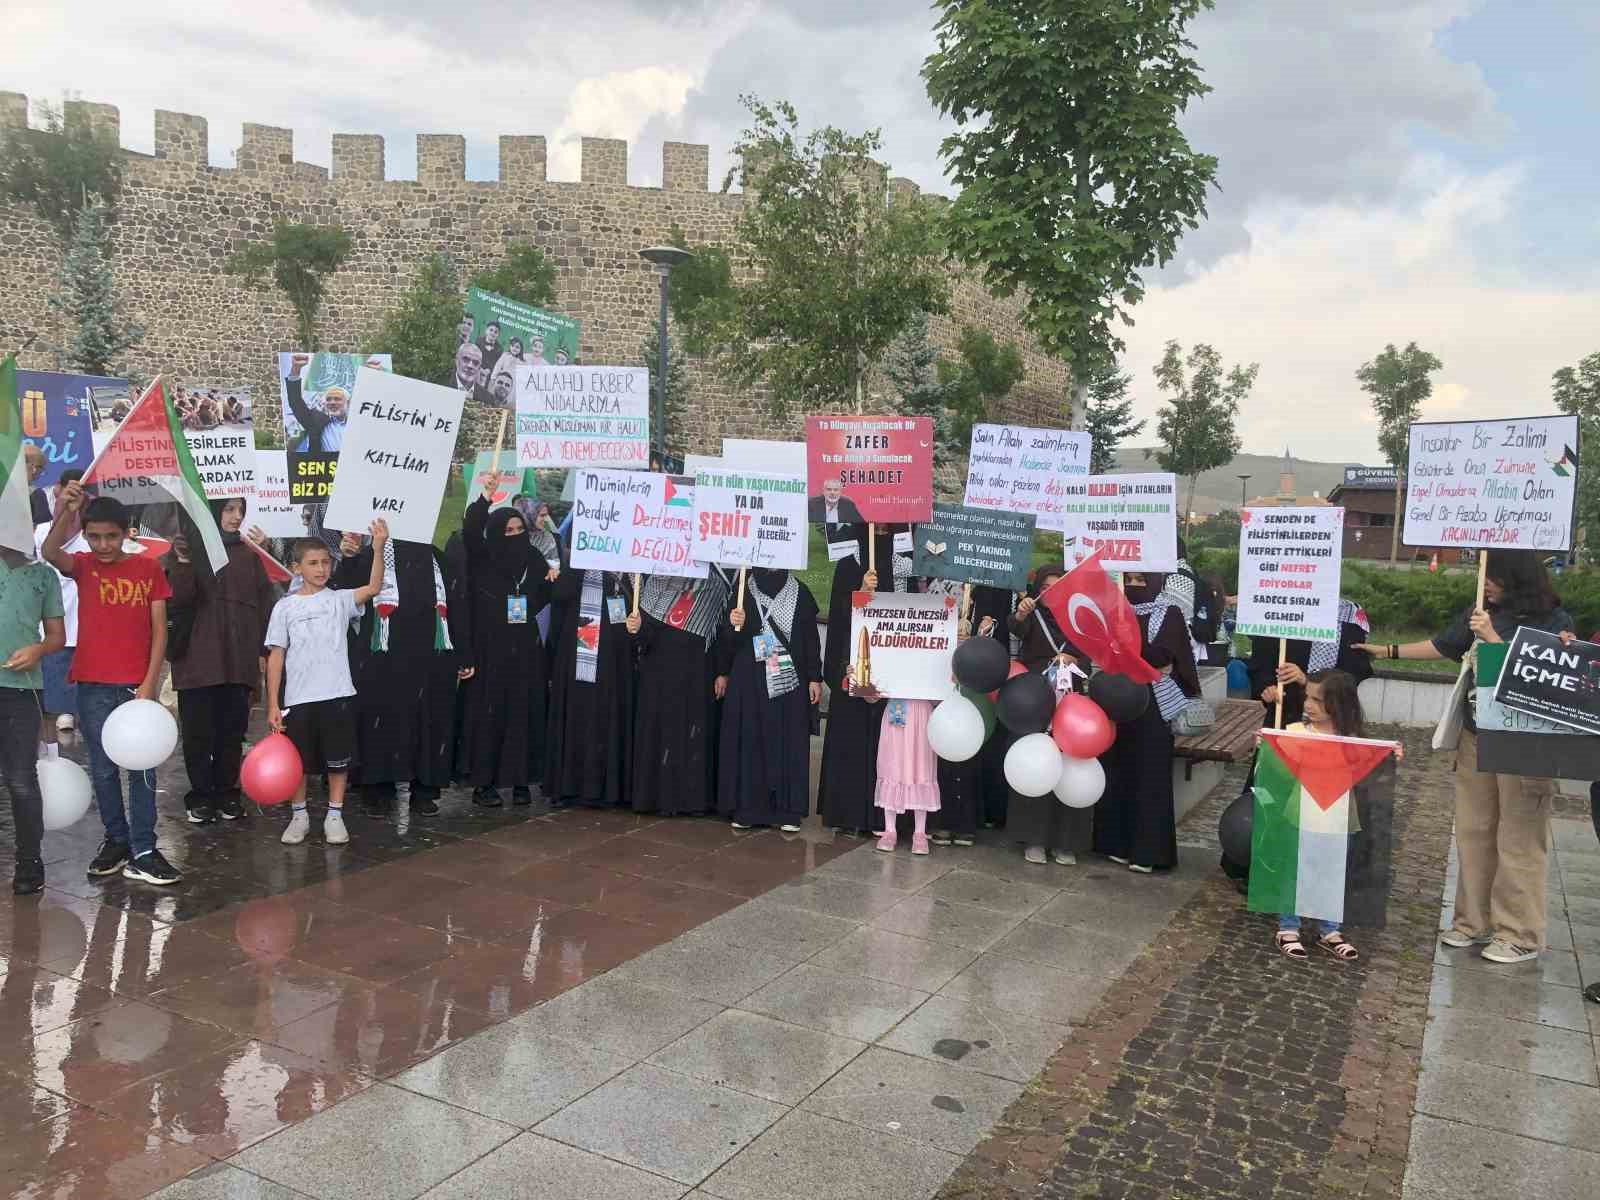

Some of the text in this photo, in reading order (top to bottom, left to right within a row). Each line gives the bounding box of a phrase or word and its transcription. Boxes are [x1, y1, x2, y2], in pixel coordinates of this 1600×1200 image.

[591, 373, 636, 394] EKBER
[845, 435, 889, 449] ZAFER
[521, 440, 553, 459] ASLA
[192, 454, 236, 467] LMAK
[364, 448, 430, 474] KATLİAM
[298, 461, 338, 478] SEN Ş
[102, 472, 133, 489] İÇİN
[840, 470, 904, 487] ŞEHADET
[204, 486, 226, 497] MAİL
[292, 480, 336, 497] BİZ DE
[1135, 484, 1172, 495] ATANLARIN
[371, 496, 405, 513] VAR!
[735, 495, 764, 509] YA DA
[698, 510, 752, 541] ŞEHİT
[760, 515, 789, 527] OLARAK
[1264, 515, 1317, 524] SENDEN DE
[1248, 529, 1331, 541] FİLİSTİNLİLERDEN
[958, 542, 1011, 557] PEK YAKINDA
[1247, 546, 1333, 558] NEFRET ETTİKLERİ
[953, 555, 1013, 572] BİLECEKLERDİR
[1259, 561, 1317, 573] GİBİ NEFRET
[1259, 578, 1313, 590] EDİYORLAR
[1253, 594, 1320, 607] SADECE SIRAN
[863, 607, 949, 621] YEMEZSEN ÖLMEZSİN
[1264, 611, 1304, 623] GELMEDİ
[876, 621, 934, 633] AMA ALIRSAN
[1237, 623, 1267, 633] UYAN
[870, 631, 949, 650] ÖLDÜRÜRLER!
[1519, 641, 1580, 670] KAN
